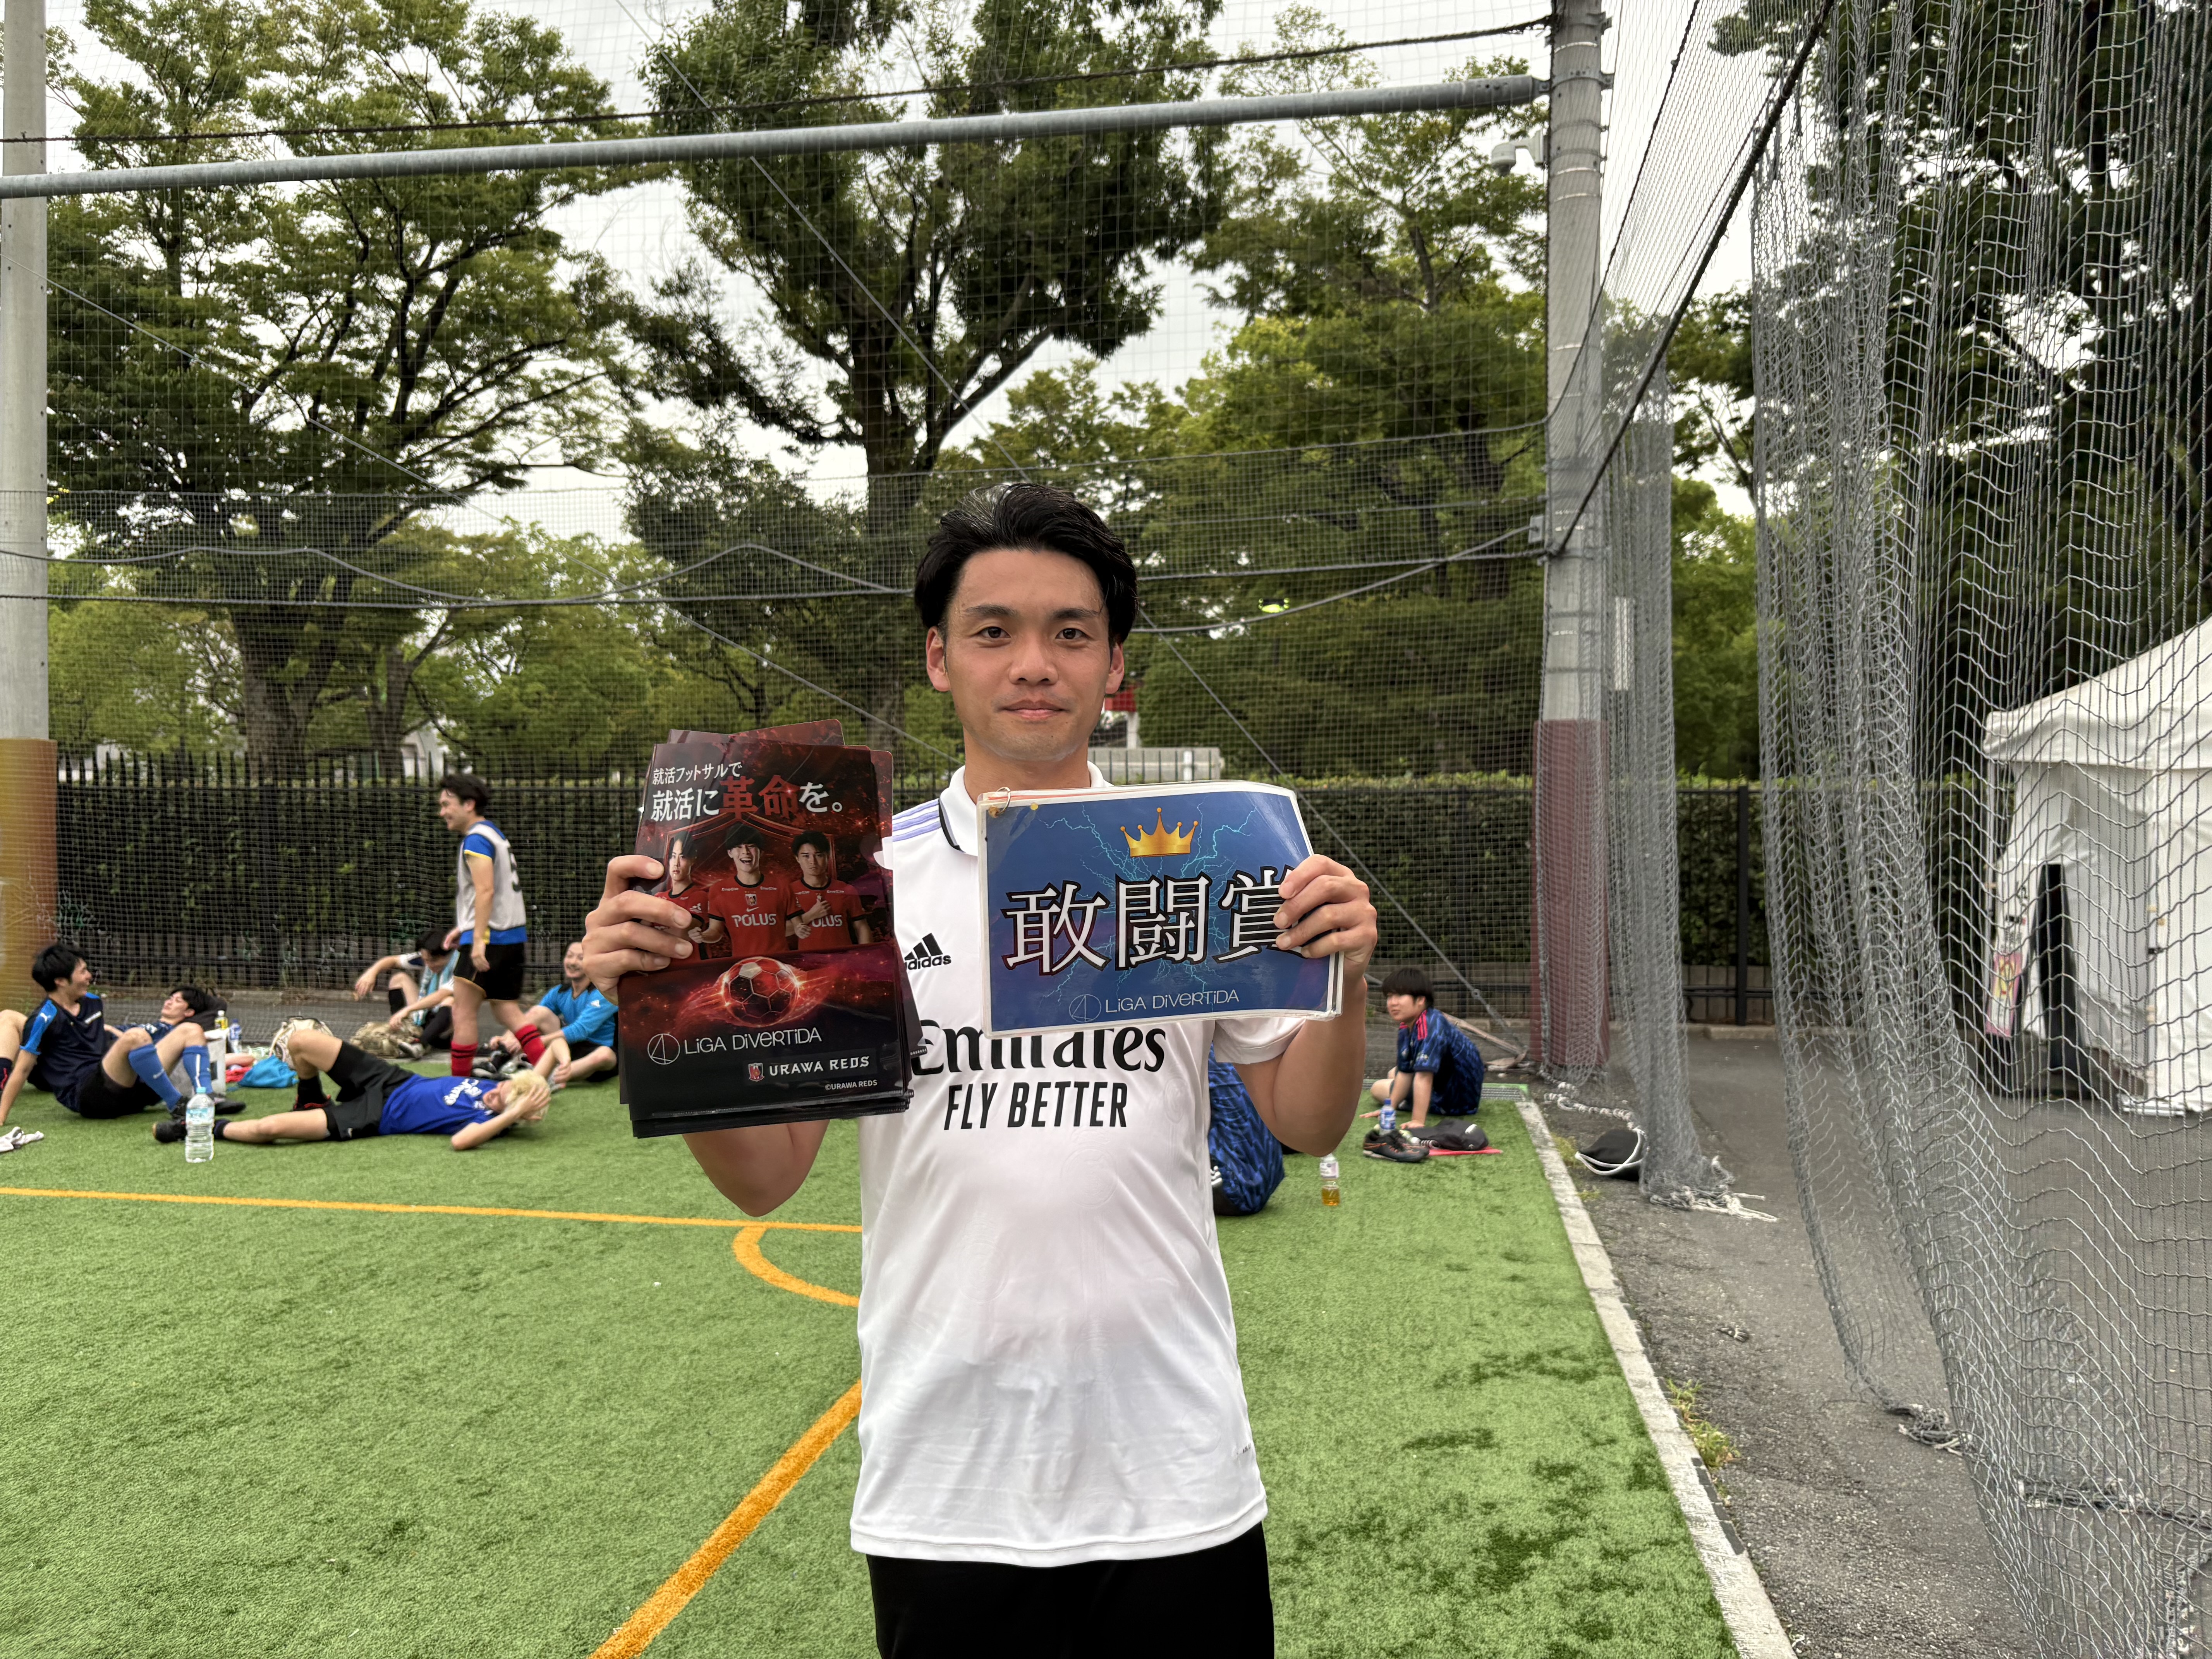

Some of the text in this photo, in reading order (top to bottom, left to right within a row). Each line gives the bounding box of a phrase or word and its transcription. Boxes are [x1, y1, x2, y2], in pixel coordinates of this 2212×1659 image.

[653, 762, 742, 785] 就活フットサルで
[651, 775, 843, 822] 就活に革命を。
[732, 913, 776, 927] POLUS
[811, 915, 843, 927] OLUS
[769, 1056, 870, 1076] URAWA REDS
[943, 1081, 1128, 1130] FLY BETTER
